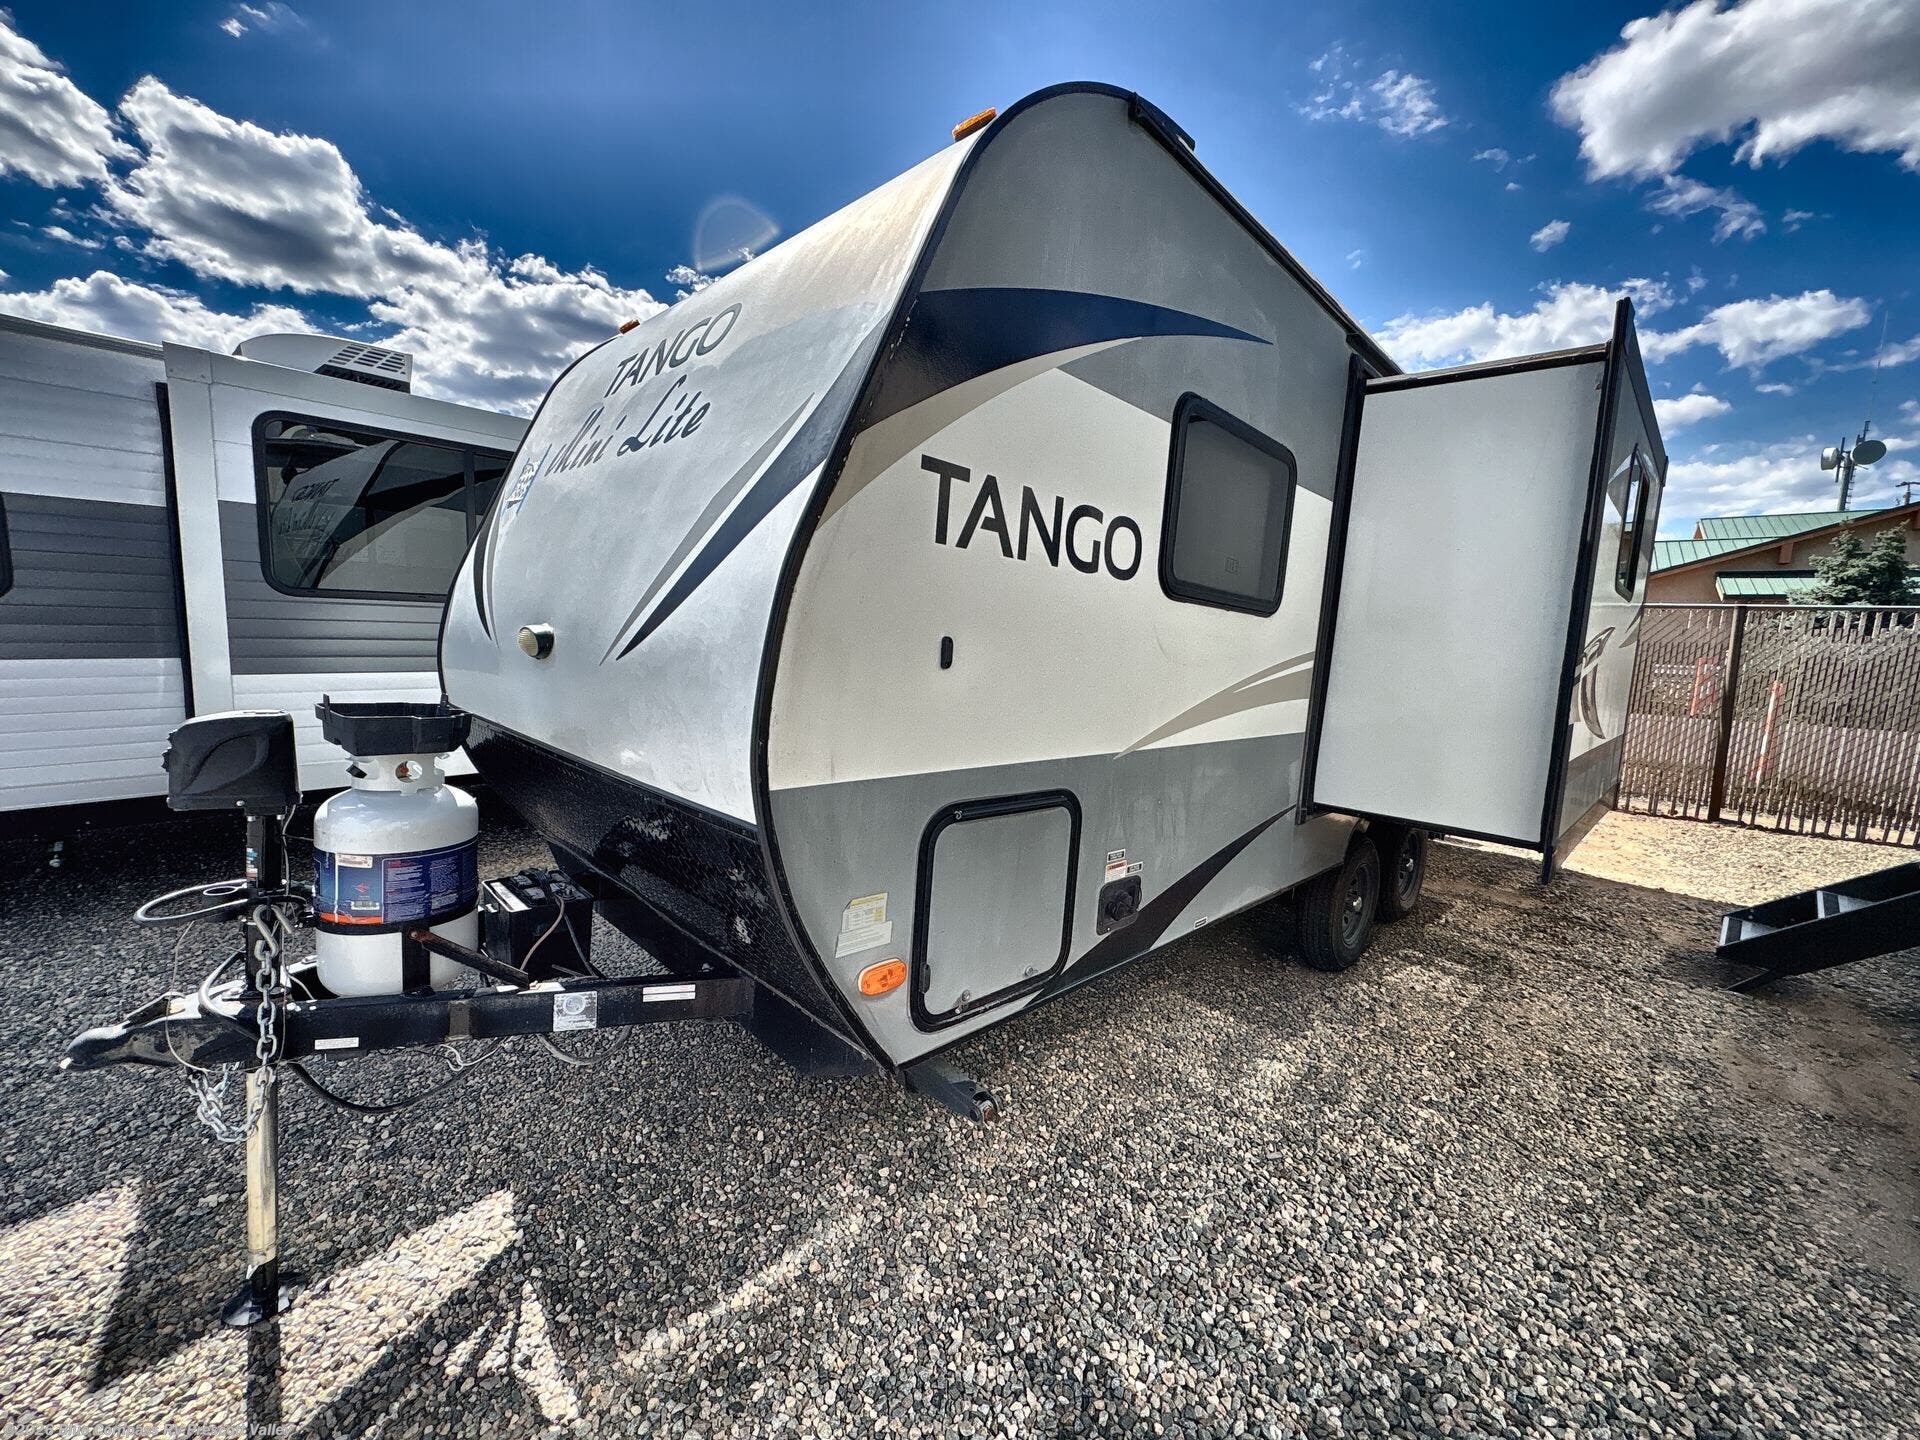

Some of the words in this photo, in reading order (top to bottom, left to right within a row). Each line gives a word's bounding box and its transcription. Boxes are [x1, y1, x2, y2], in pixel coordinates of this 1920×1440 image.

[603, 302, 742, 398] TANGO
[544, 406, 627, 477] Mini
[616, 374, 711, 457] Lite
[920, 453, 1143, 581] TANGO
